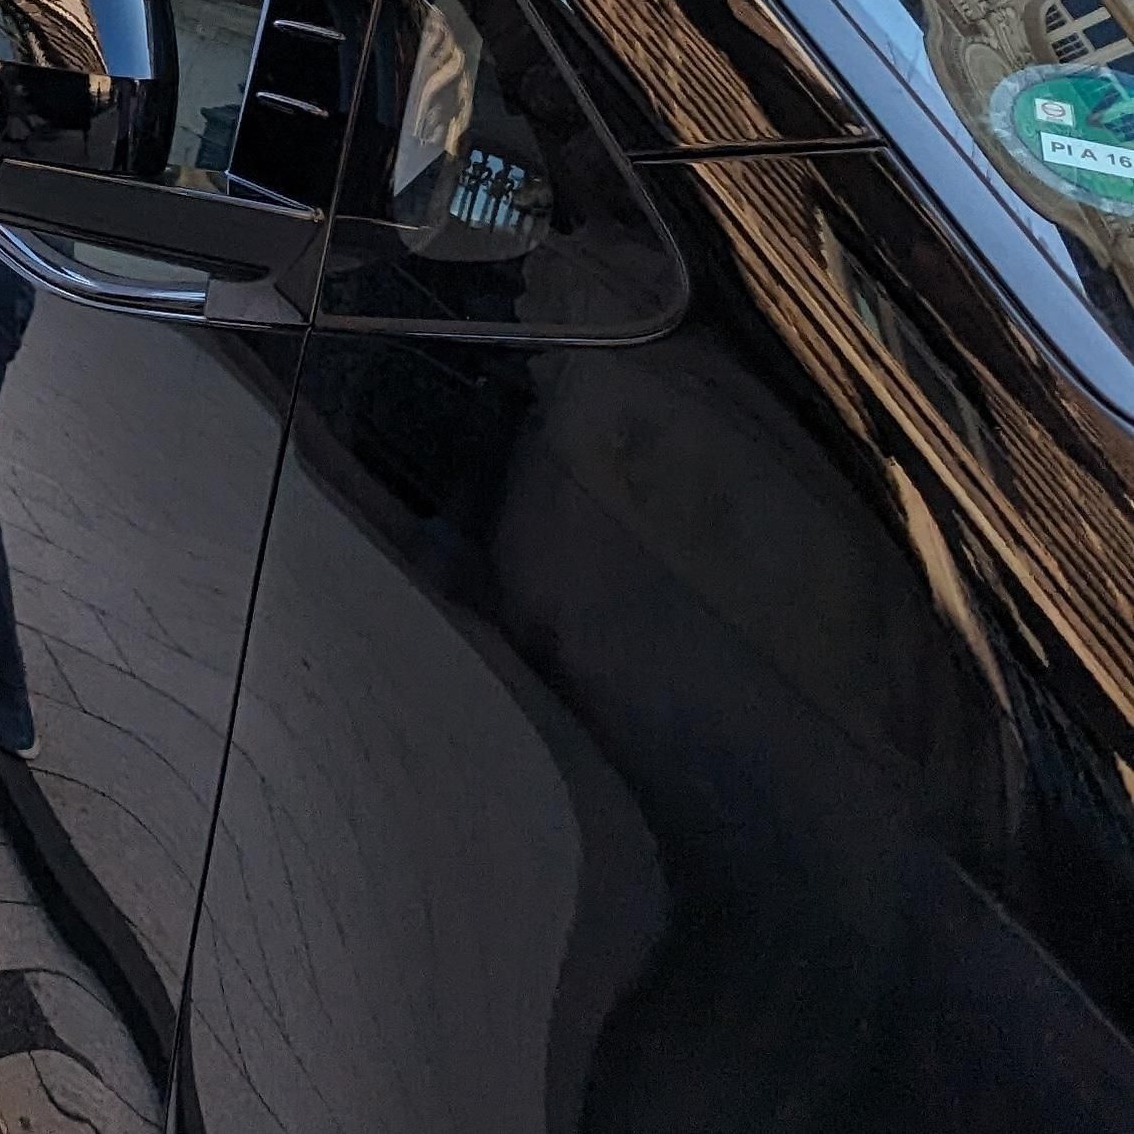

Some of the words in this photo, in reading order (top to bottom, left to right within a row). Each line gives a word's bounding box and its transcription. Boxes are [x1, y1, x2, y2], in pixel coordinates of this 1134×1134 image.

[1050, 141, 1073, 156] PI
[1080, 148, 1098, 162] A
[1107, 153, 1133, 169] 16
